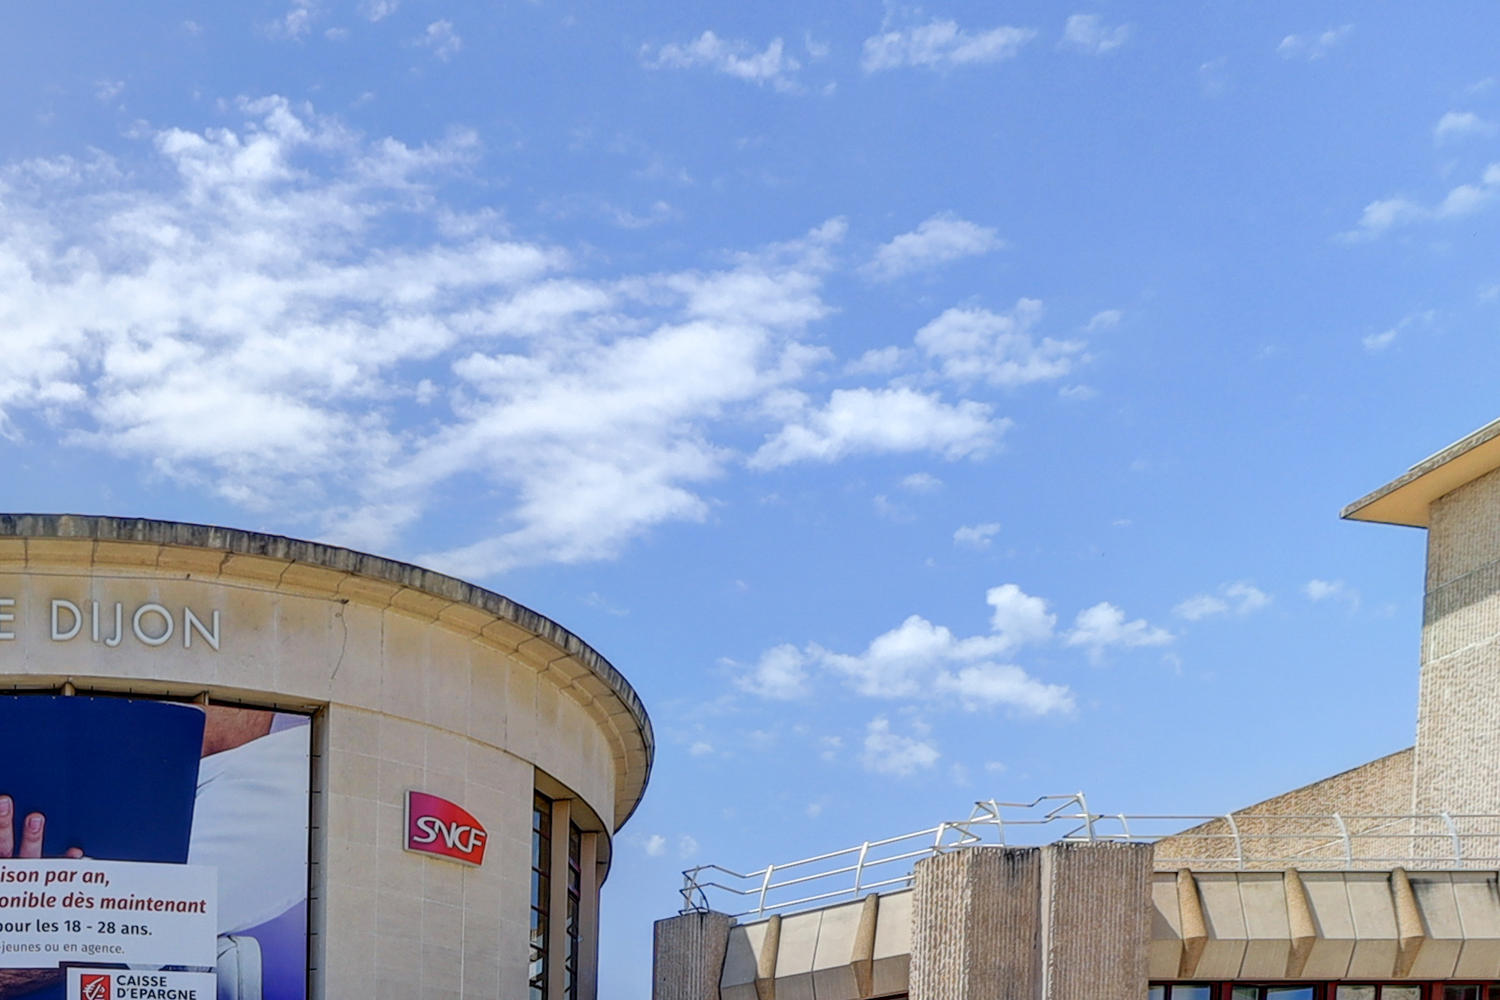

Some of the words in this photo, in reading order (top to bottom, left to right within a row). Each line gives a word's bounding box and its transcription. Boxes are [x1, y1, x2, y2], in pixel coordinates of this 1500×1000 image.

[50, 599, 220, 651] DIJON
[412, 816, 486, 853] SNCF
[44, 870, 78, 886] par
[82, 870, 110, 887] an,
[62, 892, 95, 908] dès
[100, 894, 207, 914] maintenant
[36, 918, 59, 932] les
[64, 920, 82, 932] 18
[97, 921, 116, 934] 28
[120, 922, 153, 936] ans.
[44, 943, 60, 953] ou
[63, 943, 78, 953] en
[81, 942, 126, 956] agence.
[116, 974, 168, 988] CAISSE
[116, 988, 197, 1000] D'EPARGNE
